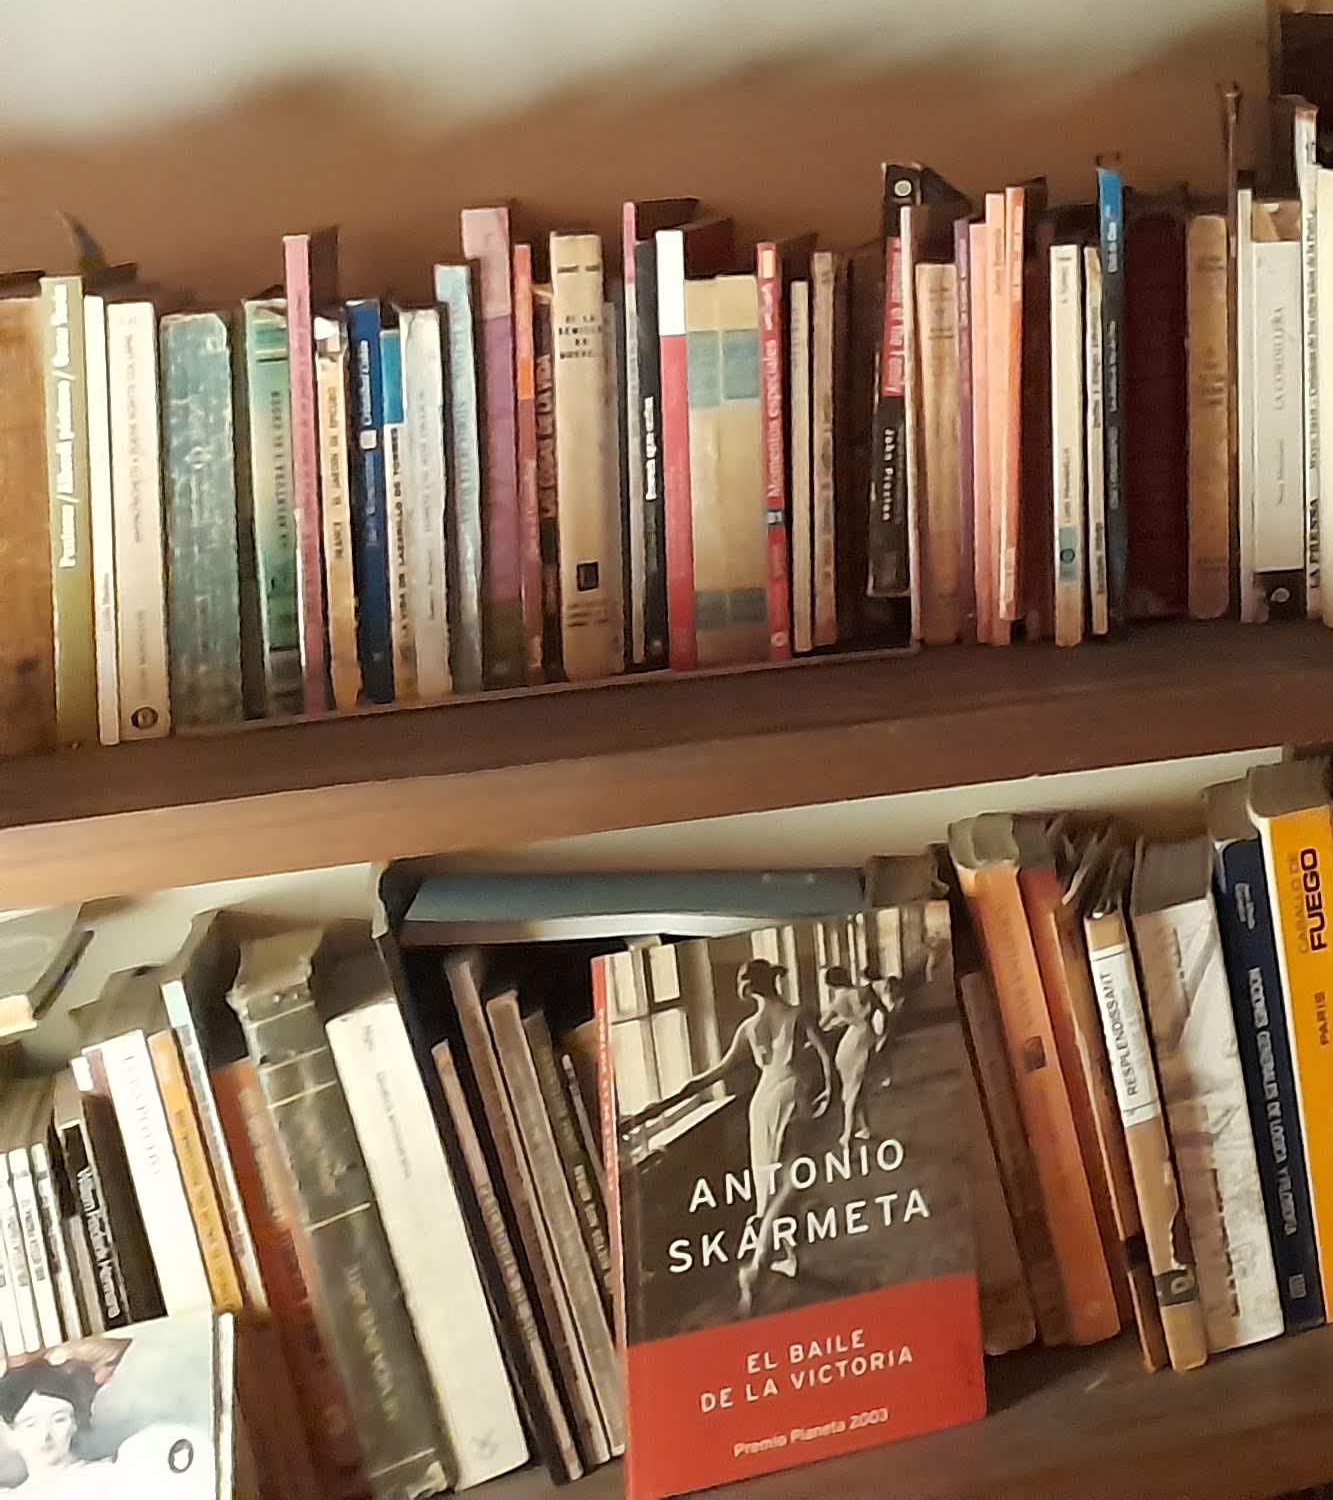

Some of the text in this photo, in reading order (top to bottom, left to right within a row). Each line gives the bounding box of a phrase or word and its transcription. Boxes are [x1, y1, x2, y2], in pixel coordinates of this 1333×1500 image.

[761, 339, 784, 498] Momentos especiales
[1271, 392, 1284, 411] LA
[389, 426, 402, 475] TORMES
[881, 428, 894, 520] John Preston
[392, 480, 403, 496] DE
[392, 501, 406, 566] LAZARILLO
[1309, 497, 1320, 588] LA PRENSA
[396, 572, 406, 587] DE
[397, 592, 408, 619] VIDA
[1288, 852, 1308, 953] CABALLO DE
[1298, 847, 1328, 950] FUEGO
[1246, 967, 1270, 1028] NOCIONES
[1312, 990, 1331, 1045] PARIS
[1097, 971, 1140, 1096] RESPLENDISSANT
[1254, 1030, 1280, 1099] GENERALES
[1264, 1101, 1281, 1120] DE
[688, 1138, 908, 1213] ANTONIO
[666, 1190, 931, 1275] SKÁRMETA
[699, 1347, 914, 1414] DE LA VICTORIA
[745, 1328, 867, 1375] EL BAILE
[733, 1407, 890, 1459] Premio Planeta 2003
